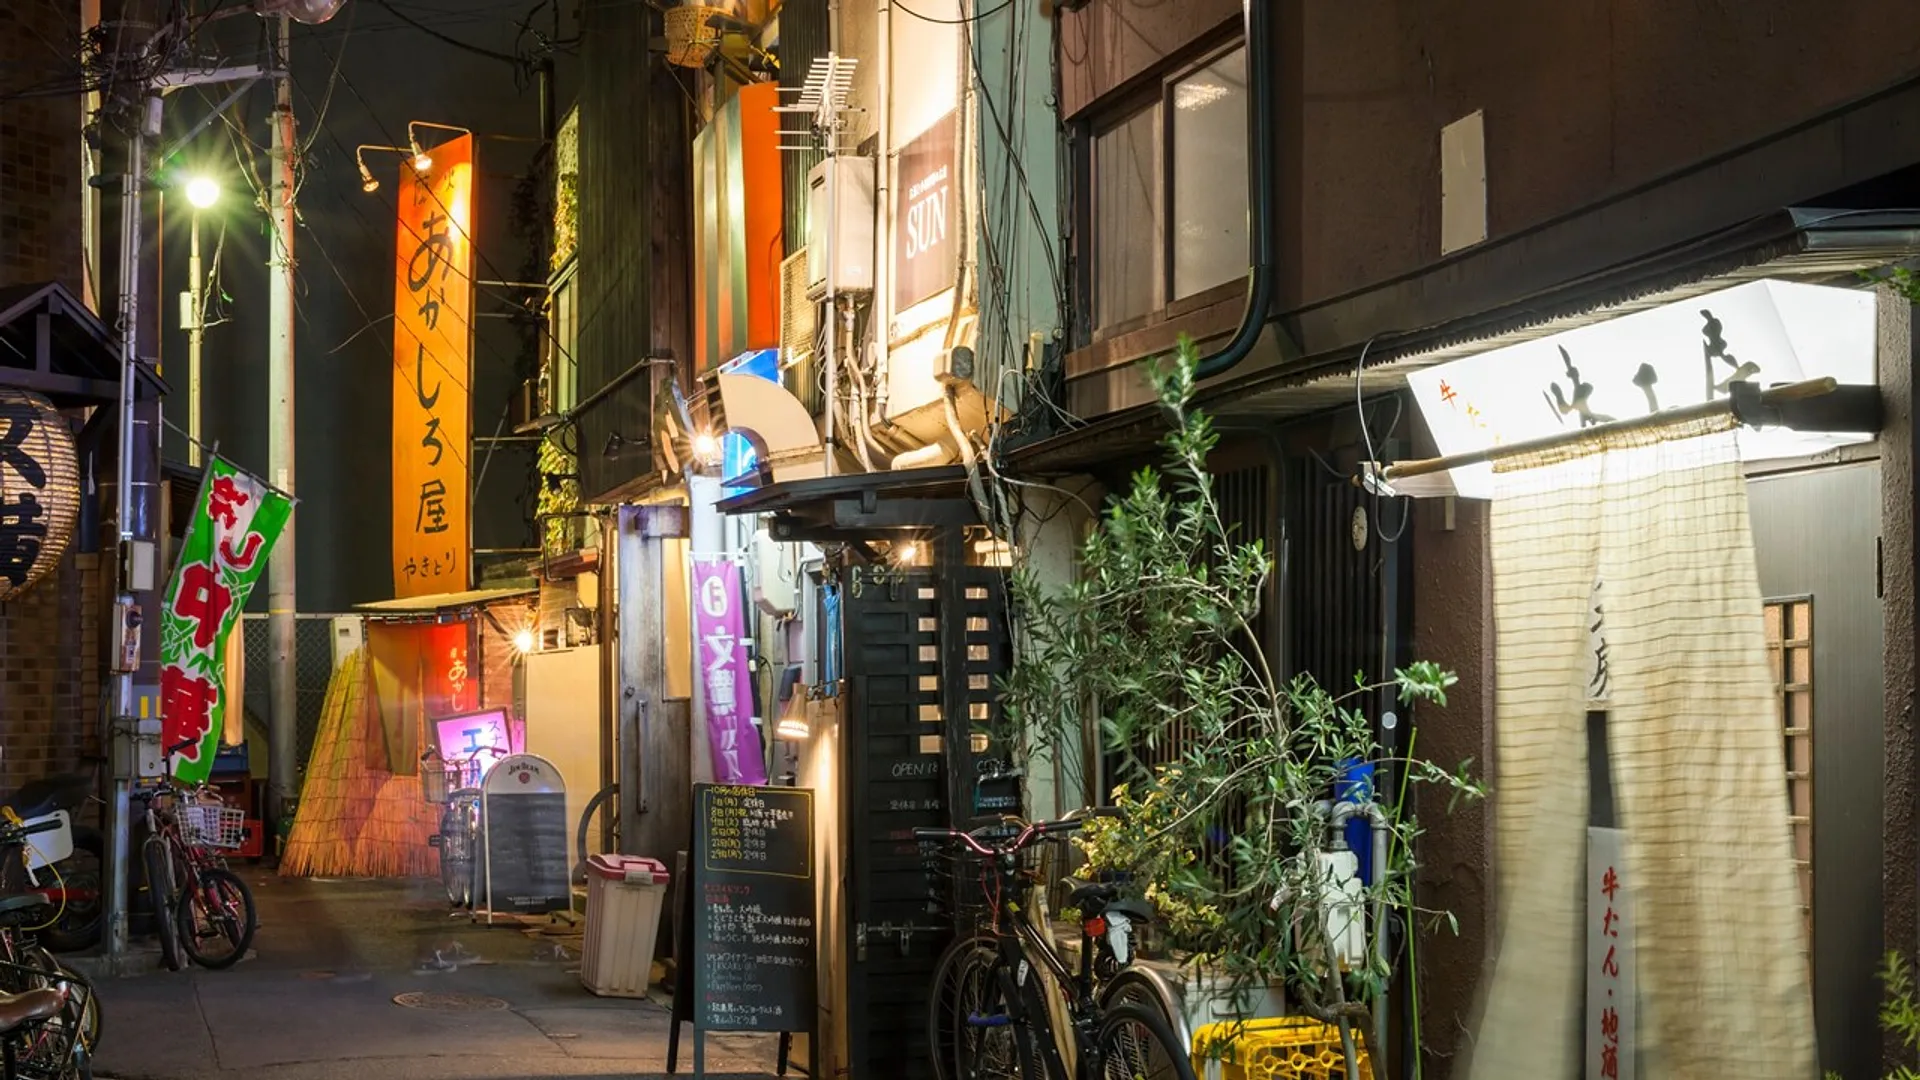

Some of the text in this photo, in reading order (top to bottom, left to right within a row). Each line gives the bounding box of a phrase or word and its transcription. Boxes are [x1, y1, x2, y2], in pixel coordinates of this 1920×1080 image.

[906, 185, 949, 260] SUN
[407, 210, 455, 534] あかしろ屋
[402, 548, 456, 584] やきとり
[892, 763, 924, 777] OPEN
